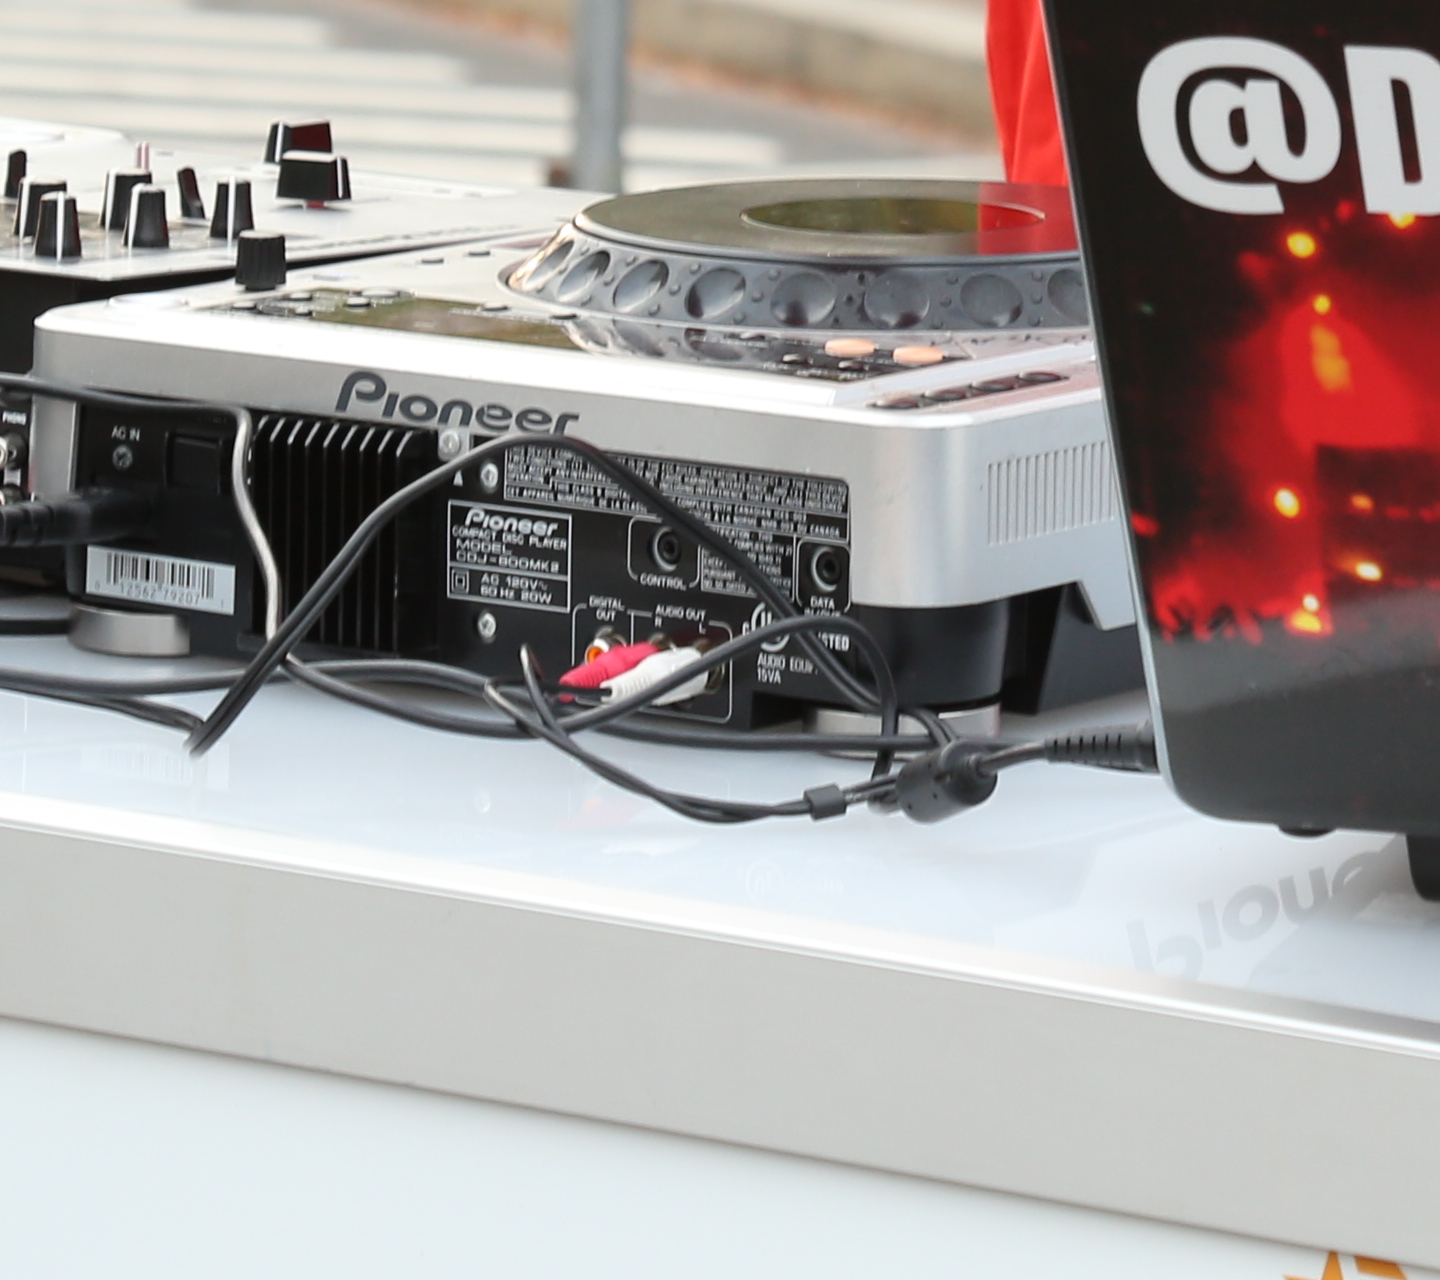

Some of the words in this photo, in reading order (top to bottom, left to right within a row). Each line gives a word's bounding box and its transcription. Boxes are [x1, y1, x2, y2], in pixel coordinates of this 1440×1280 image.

[335, 371, 580, 436] Pioneer
[111, 425, 127, 440] AC
[129, 427, 141, 442] IN
[464, 507, 558, 537] Pioneer
[456, 538, 513, 556] MODEL
[528, 535, 567, 552] PLAYER
[639, 572, 687, 591] CONTROL
[588, 594, 625, 612] DIGITAL
[810, 595, 836, 610] DATA
[595, 608, 617, 622] OUT
[655, 604, 685, 620] AUDIO
[685, 608, 707, 623] OUT
[757, 651, 786, 671] AUDIO
